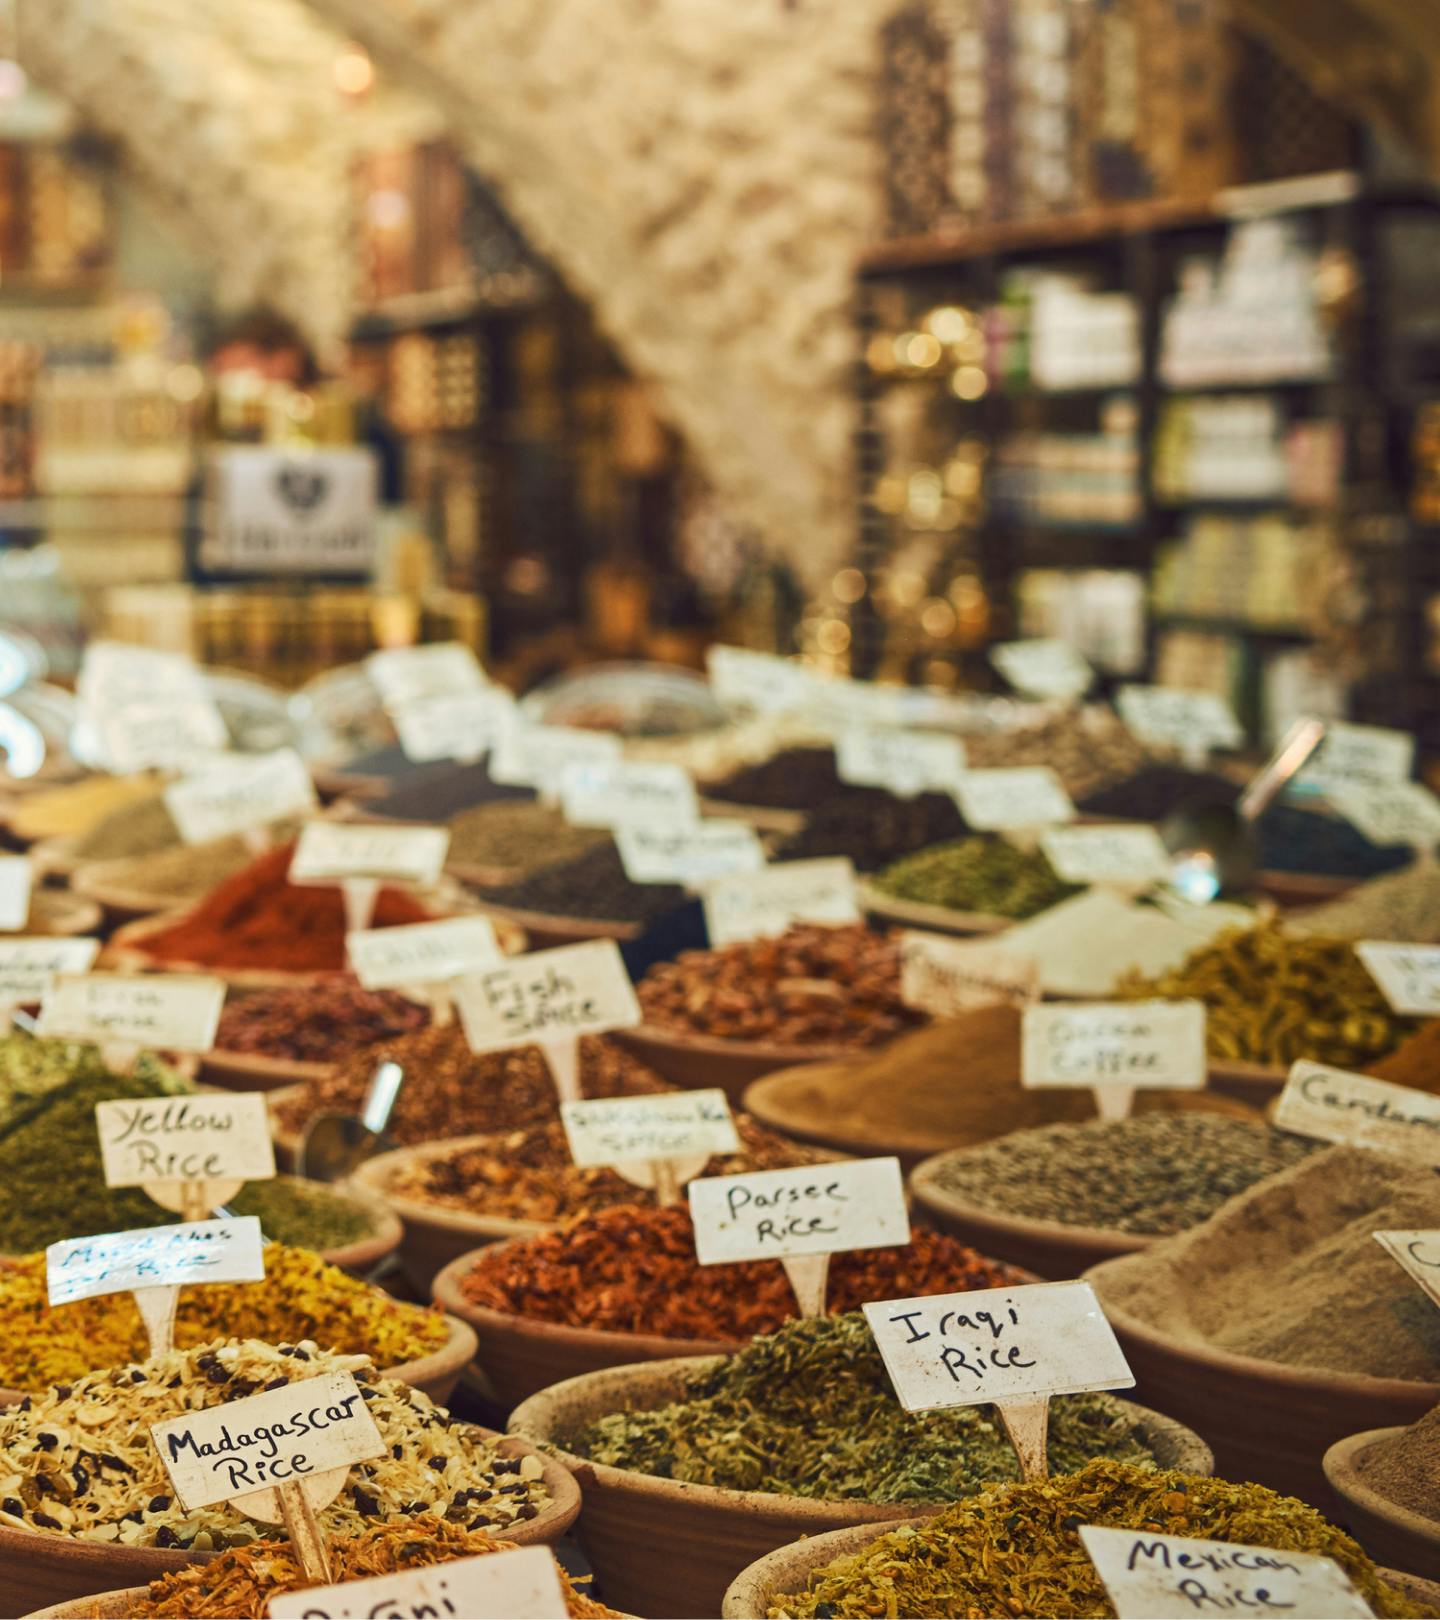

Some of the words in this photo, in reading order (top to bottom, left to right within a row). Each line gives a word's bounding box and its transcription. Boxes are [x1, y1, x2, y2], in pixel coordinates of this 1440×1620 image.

[481, 965, 576, 1008] Fish
[111, 1103, 233, 1142] Yellow
[126, 1139, 226, 1177] Rice
[727, 1181, 849, 1220] Parsee
[757, 1217, 839, 1243] Rice
[889, 1298, 1019, 1343] Iraqi
[940, 1345, 1037, 1382] Rice
[166, 1394, 359, 1463] Madagascar
[212, 1453, 315, 1490] Rice
[1127, 1540, 1302, 1576] Mexican
[1178, 1578, 1297, 1610] Rice
